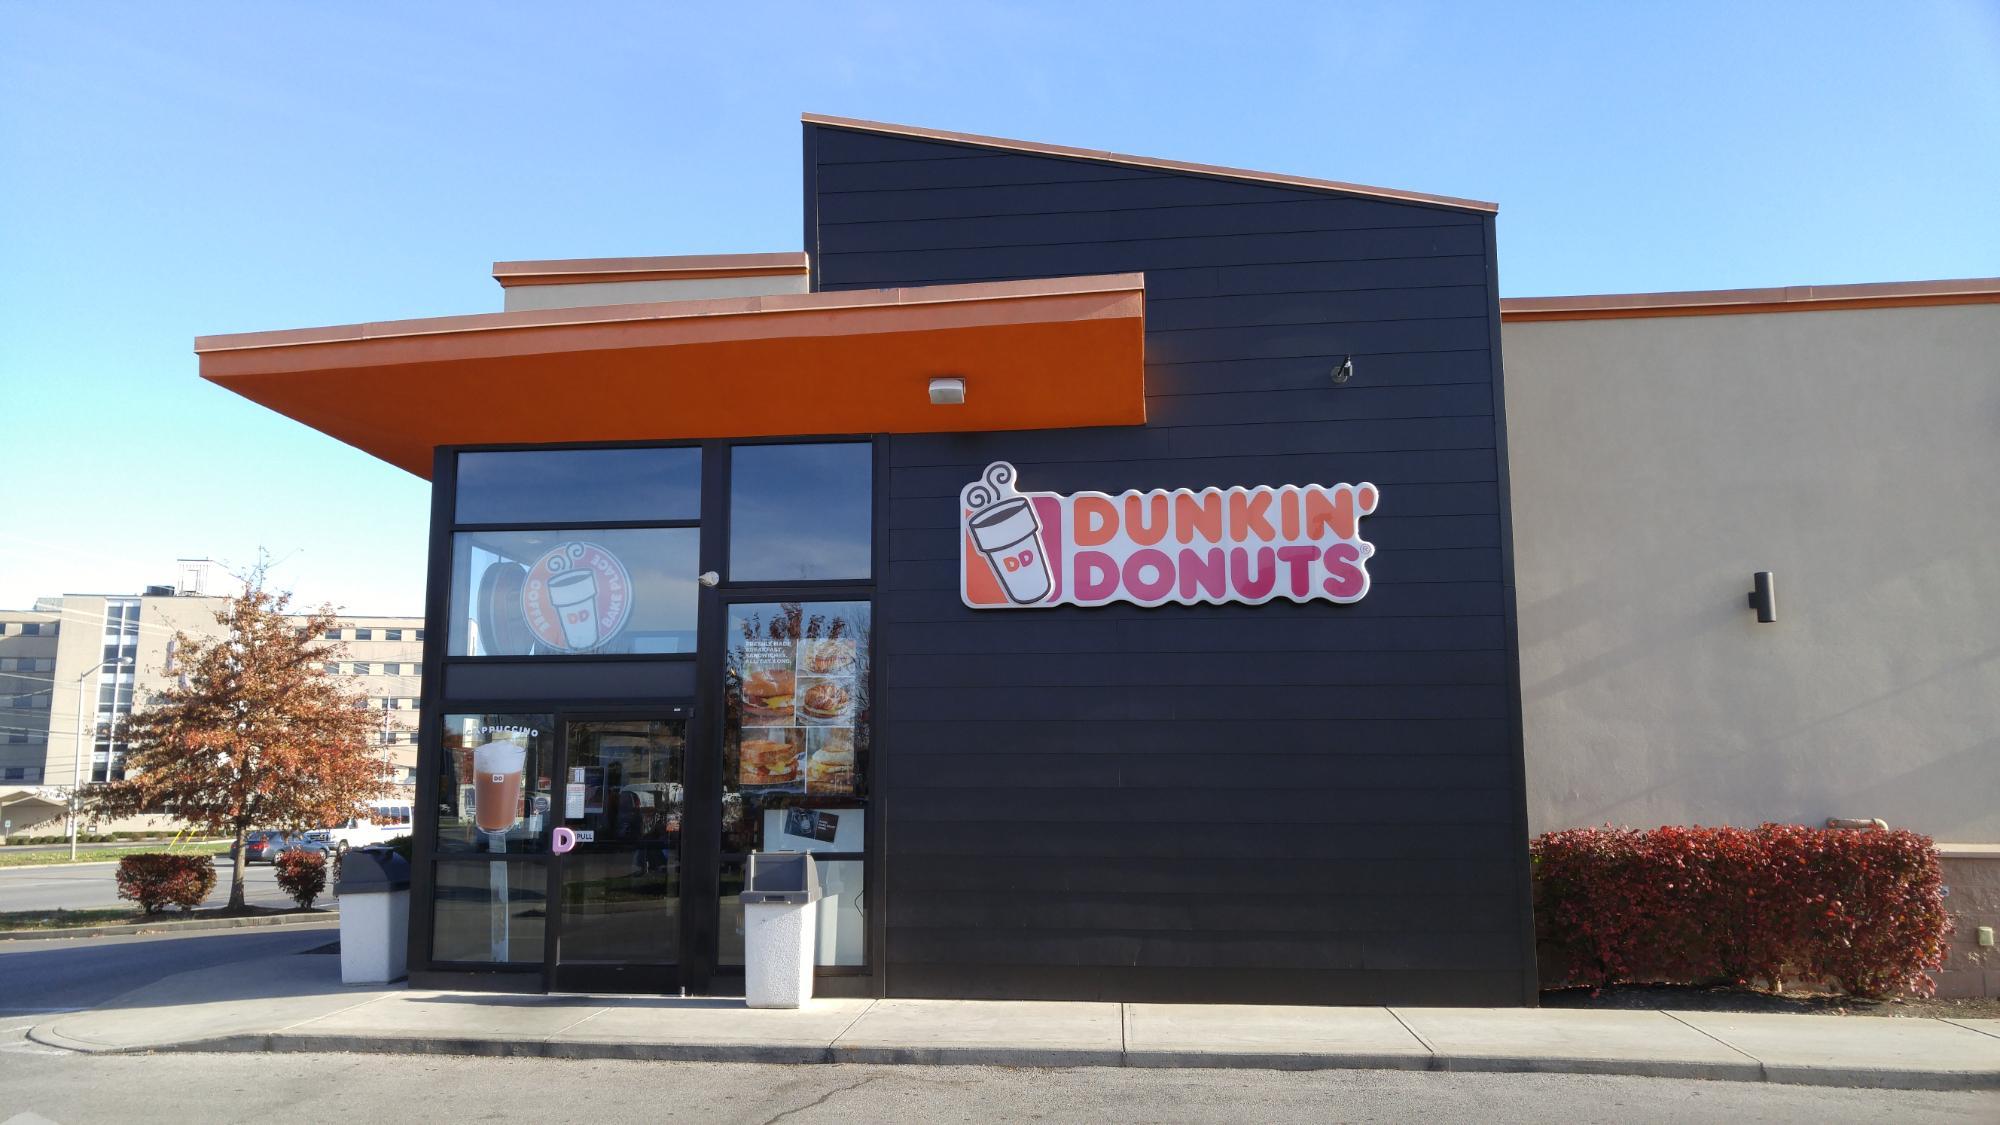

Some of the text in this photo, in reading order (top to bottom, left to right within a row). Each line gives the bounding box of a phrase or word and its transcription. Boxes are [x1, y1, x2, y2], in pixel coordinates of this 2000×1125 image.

[1073, 488, 1374, 546] DUNKIN'
[1004, 549, 1034, 573] DD
[1073, 543, 1364, 601] DONUTS
[567, 609, 591, 625] DD
